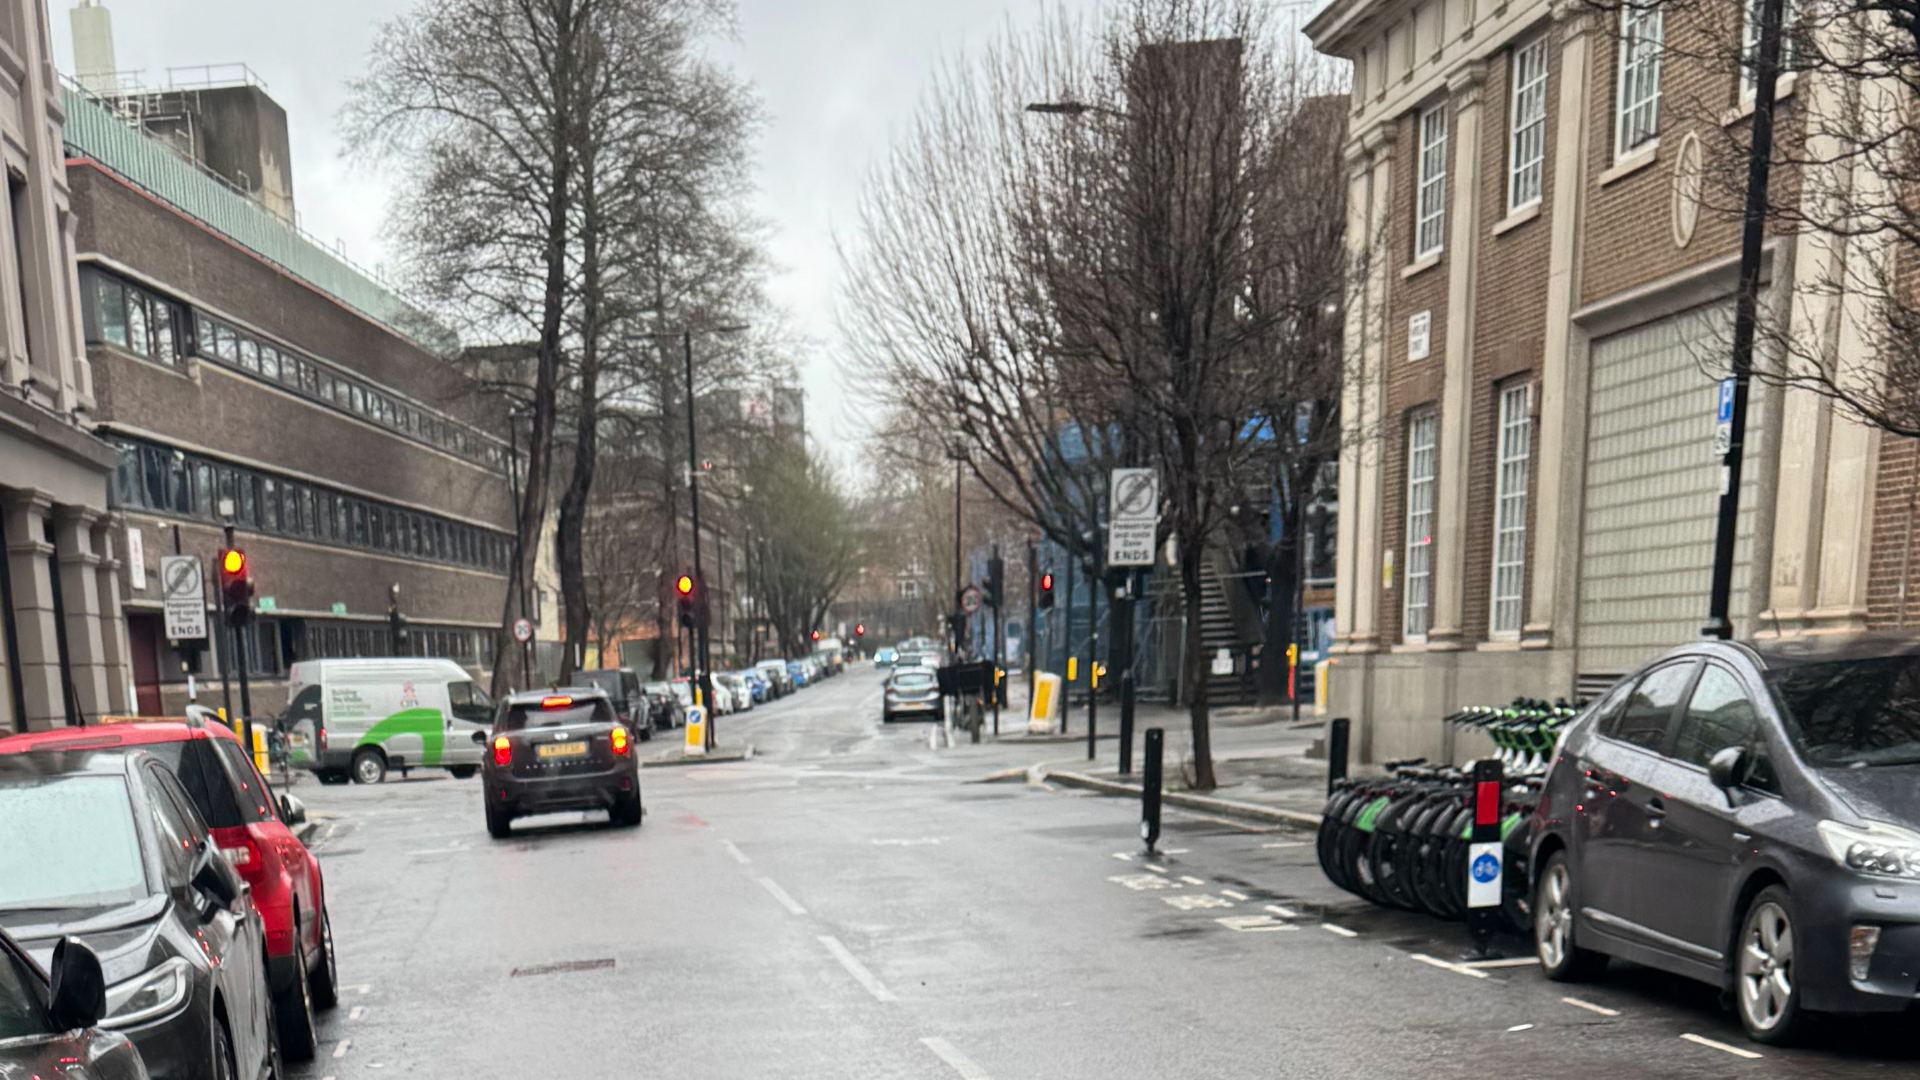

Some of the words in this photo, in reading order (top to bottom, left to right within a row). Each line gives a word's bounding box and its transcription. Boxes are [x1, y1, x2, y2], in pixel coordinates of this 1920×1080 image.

[1720, 380, 1734, 418] P
[1114, 549, 1150, 561] ENDS
[170, 625, 202, 636] ENDS
